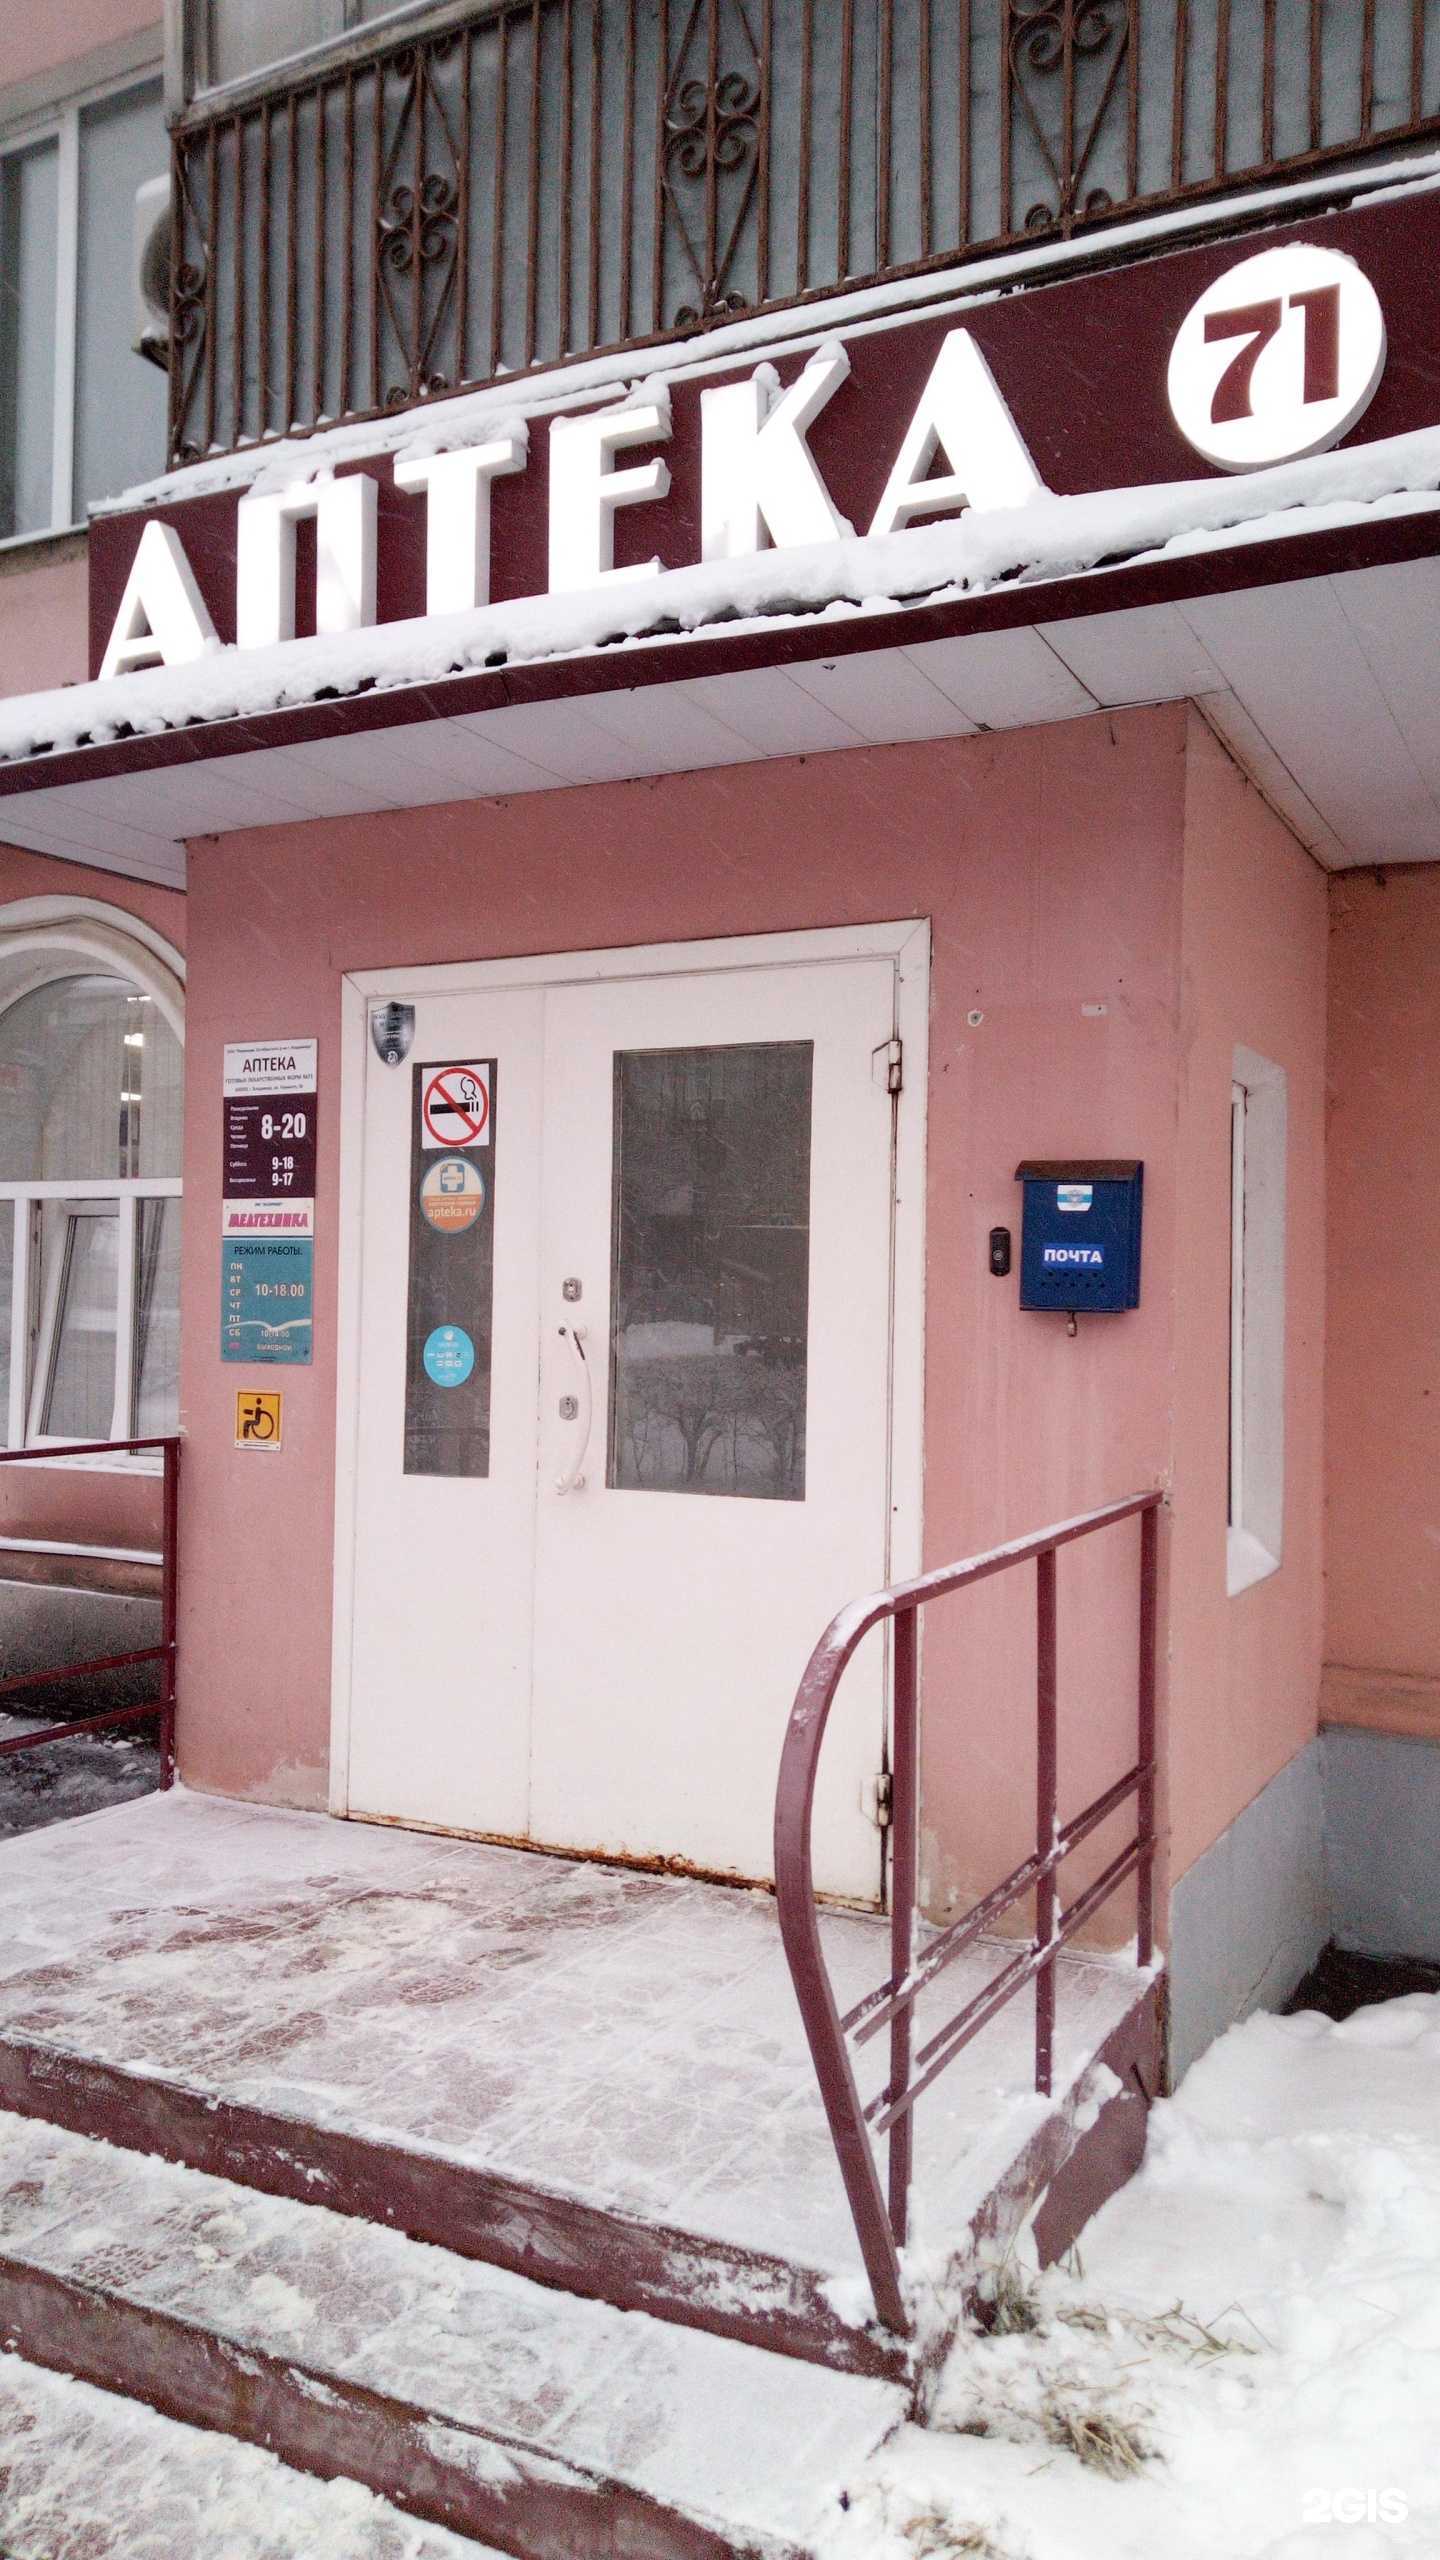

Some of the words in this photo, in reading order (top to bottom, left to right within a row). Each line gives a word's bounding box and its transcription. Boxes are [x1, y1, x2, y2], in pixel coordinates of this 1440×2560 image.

[98, 329, 1047, 681] АПТЕКА
[1204, 283, 1340, 424] 71
[243, 1056, 296, 1073] АПТЕКА
[261, 1113, 306, 1139] 8-20
[272, 1156, 294, 1170] 9-18
[272, 1172, 294, 1186] 9-17
[429, 1206, 477, 1219] apteka.ru
[234, 1246, 265, 1256] РЕЖИМ
[1043, 1248, 1103, 1263] ПОЧТА
[230, 1288, 241, 1296] СР
[229, 1301, 241, 1309] ЧТ
[229, 1315, 241, 1323] ПТ
